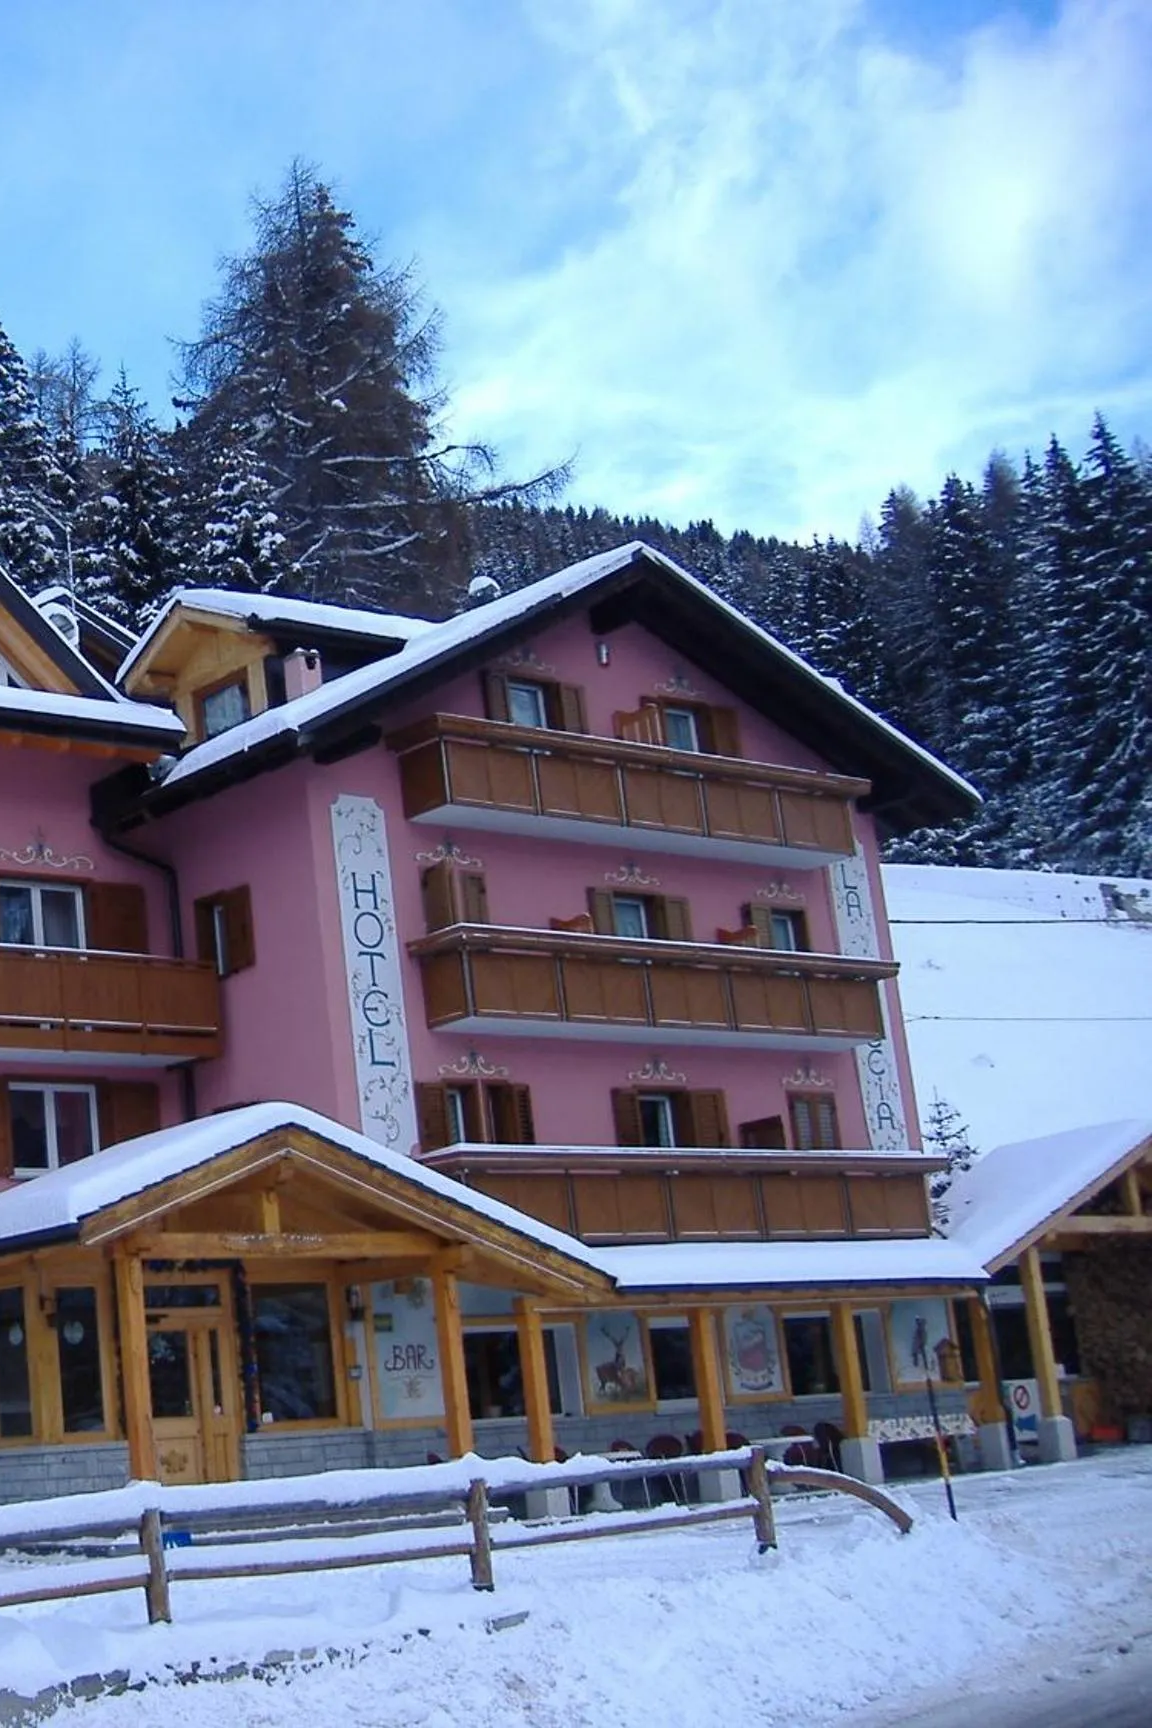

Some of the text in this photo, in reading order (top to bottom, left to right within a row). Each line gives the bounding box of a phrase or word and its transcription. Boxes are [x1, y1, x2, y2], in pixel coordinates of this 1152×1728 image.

[840, 863, 863, 918] LA
[350, 871, 396, 1068] HOTEL
[384, 1344, 435, 1372] BAR
